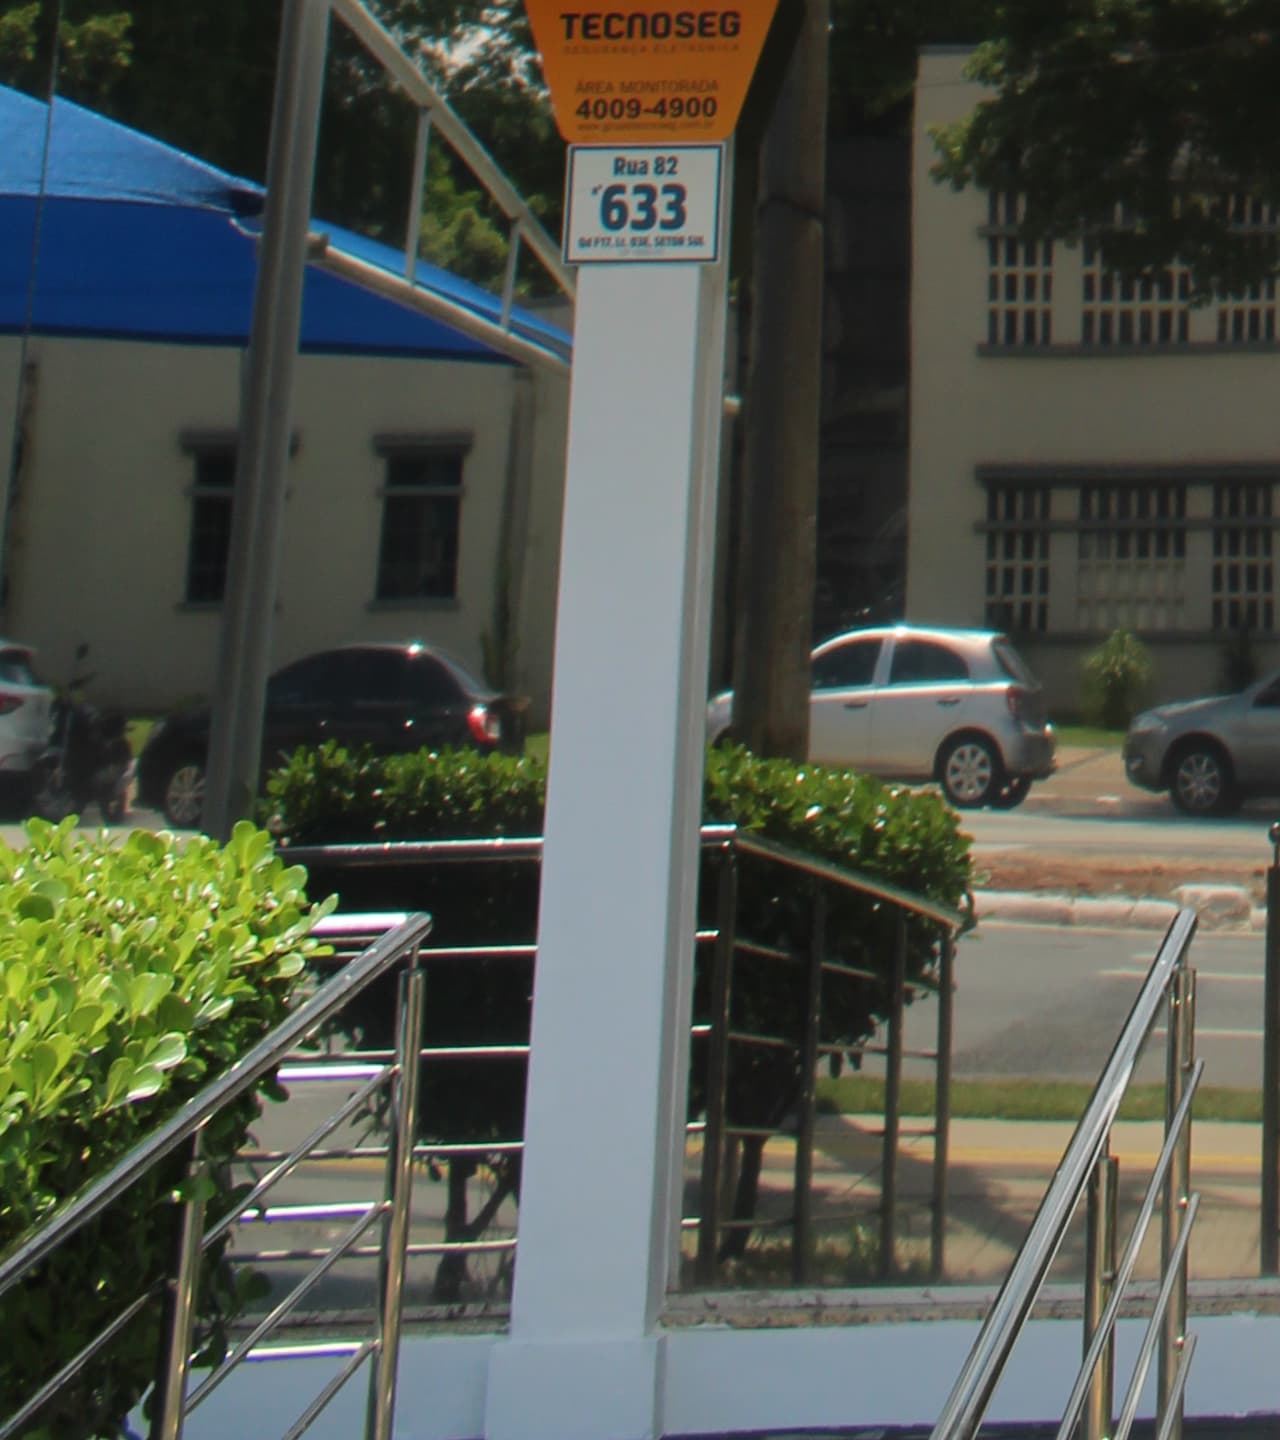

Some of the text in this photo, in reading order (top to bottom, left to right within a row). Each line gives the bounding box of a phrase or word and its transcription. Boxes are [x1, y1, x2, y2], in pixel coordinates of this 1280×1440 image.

[560, 10, 742, 41] TECNOSEG
[620, 79, 719, 93] MONITORADA
[575, 97, 718, 120] 4009-4900
[613, 155, 679, 176] Rua 82
[600, 182, 687, 232] 633
